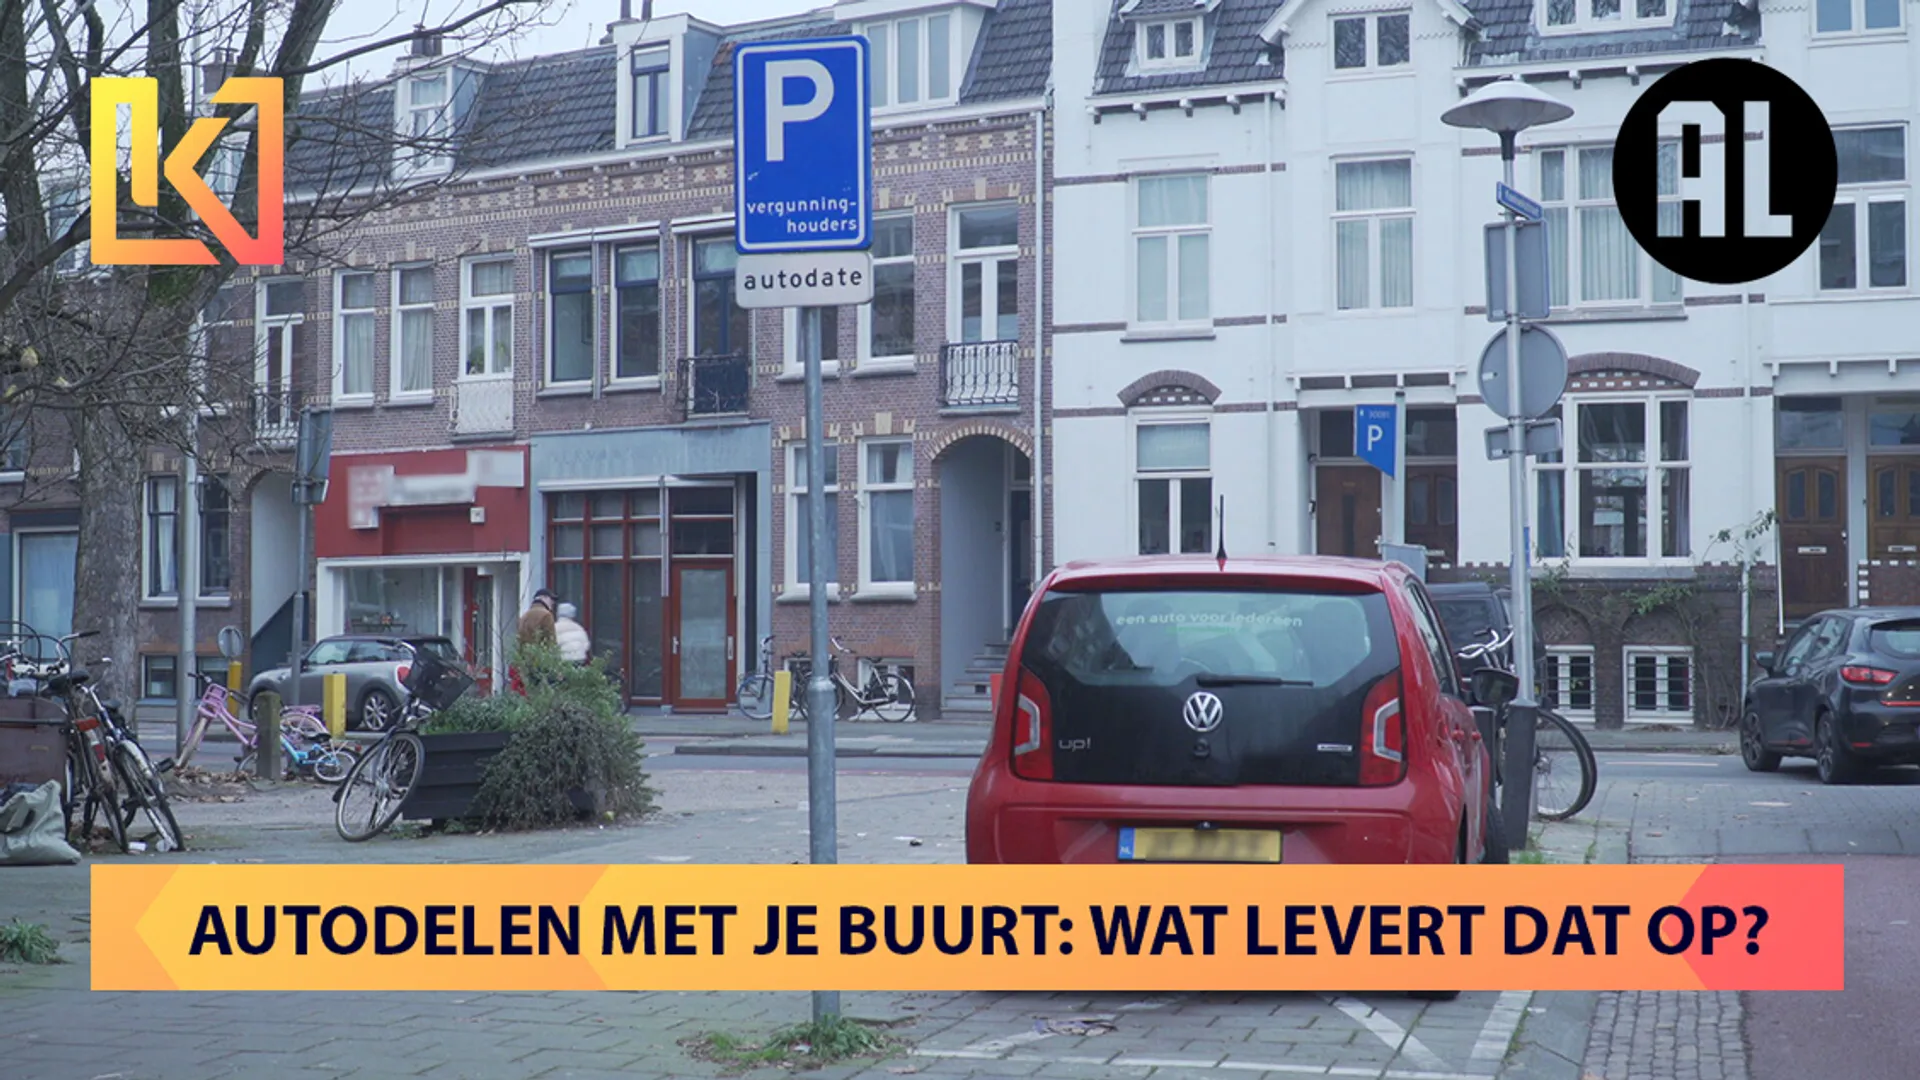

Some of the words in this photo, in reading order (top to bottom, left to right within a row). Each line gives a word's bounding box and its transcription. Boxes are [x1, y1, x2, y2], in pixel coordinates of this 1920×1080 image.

[765, 58, 834, 162] P
[746, 196, 857, 217] vergunning-
[786, 216, 857, 233] houders
[743, 267, 863, 290] autodate
[1367, 424, 1383, 451] P
[1115, 615, 1145, 626] een
[1150, 612, 1186, 624] auto
[1190, 612, 1226, 623] voor
